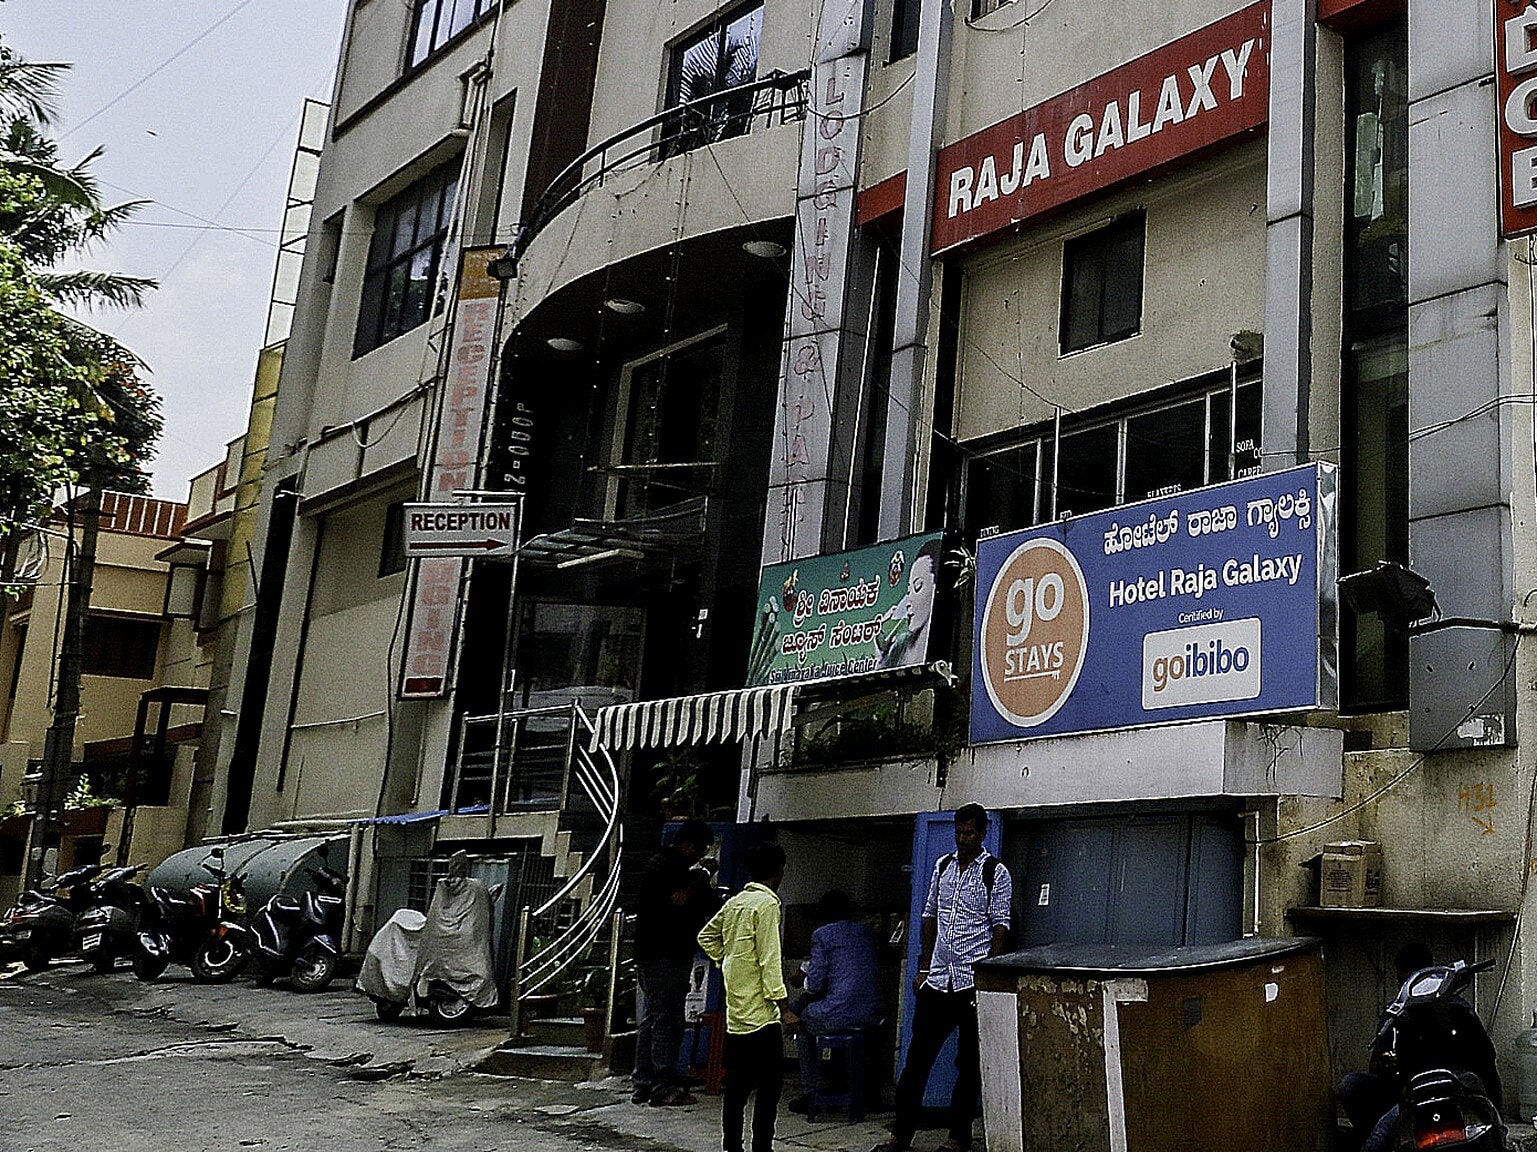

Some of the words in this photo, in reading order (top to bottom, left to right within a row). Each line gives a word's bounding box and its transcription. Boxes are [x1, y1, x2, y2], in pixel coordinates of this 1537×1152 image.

[948, 132, 1051, 219] RAJA
[1063, 38, 1256, 169] GALAXY
[411, 512, 510, 533] RECEPTION
[1102, 507, 1180, 556] ಹೋಟೆಲ್
[1187, 503, 1237, 536] ರಾಜಾ
[1108, 574, 1166, 608] Hotel
[1170, 563, 1218, 603] Raja
[1222, 553, 1304, 590] Galaxy
[1004, 571, 1065, 647] go
[1178, 609, 1210, 624] Certified
[1211, 606, 1224, 621] by
[821, 660, 846, 677] Juice
[847, 657, 879, 675] Center
[1004, 641, 1064, 676] STAYS
[1152, 638, 1250, 693] goibibo
